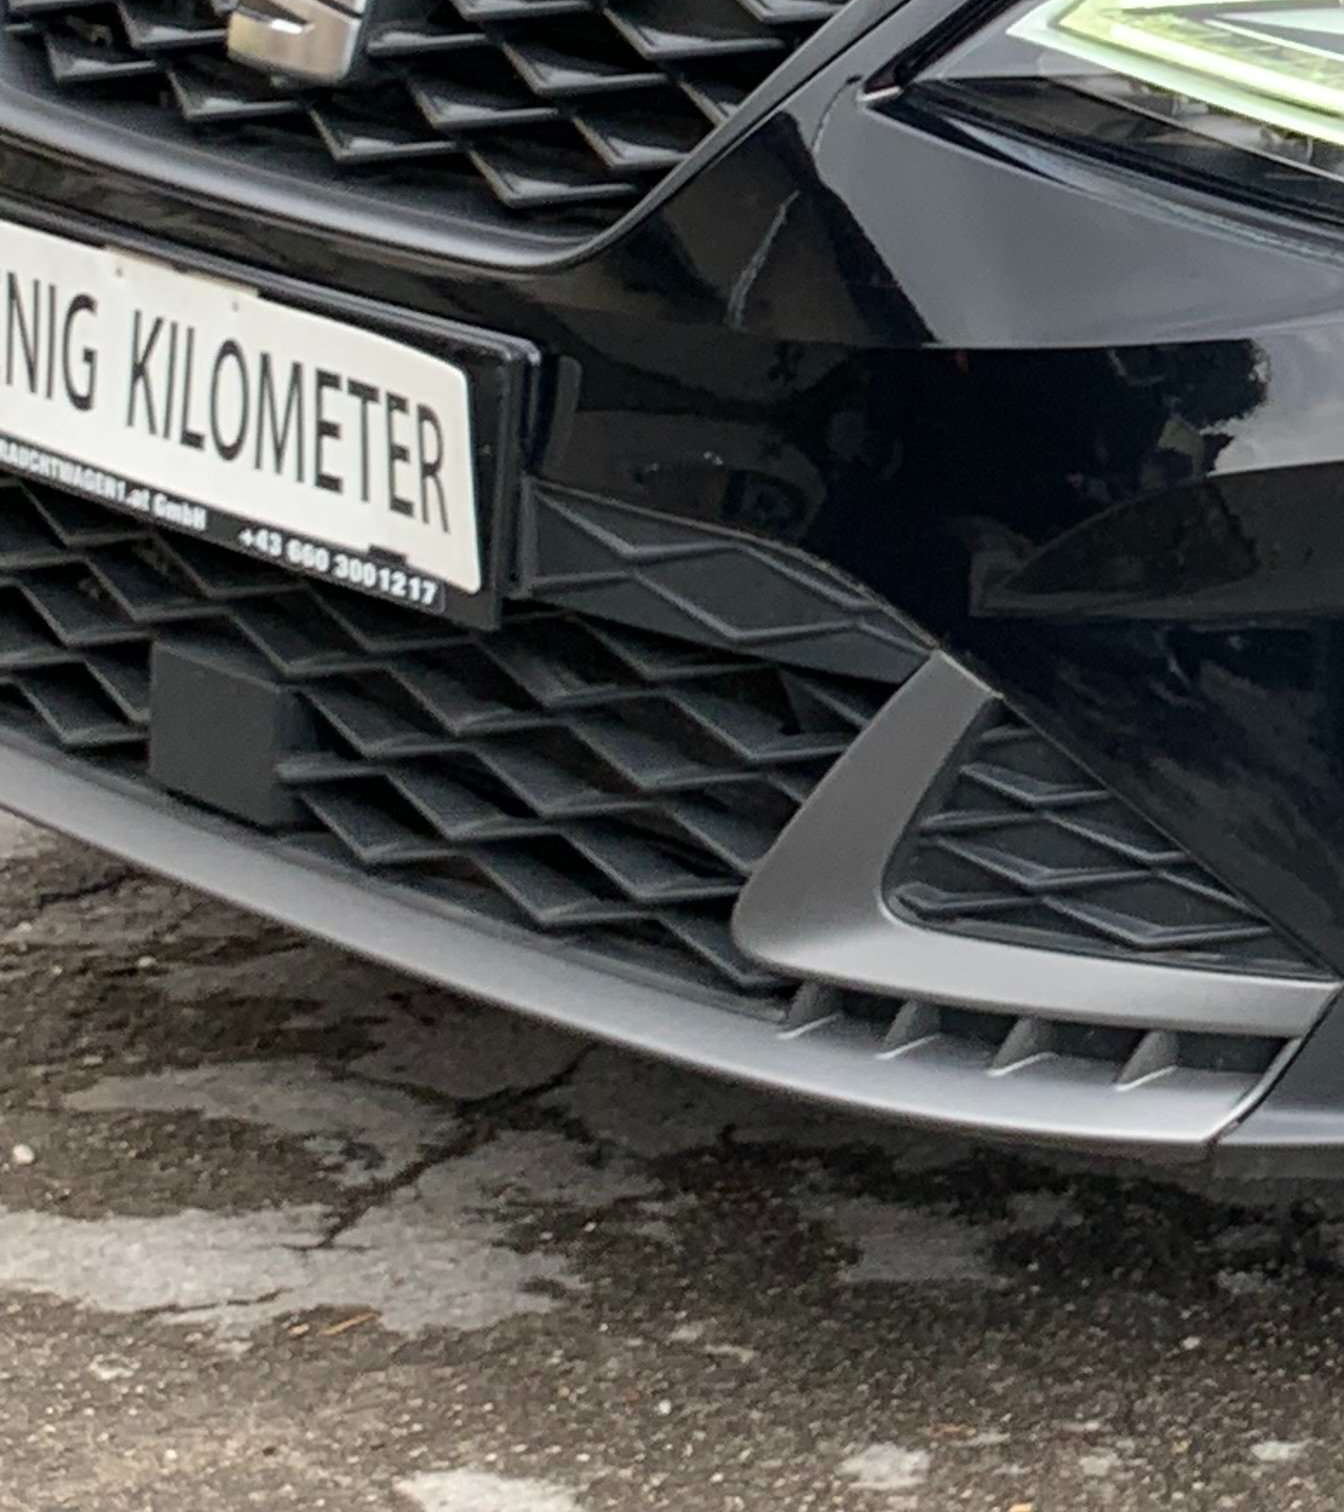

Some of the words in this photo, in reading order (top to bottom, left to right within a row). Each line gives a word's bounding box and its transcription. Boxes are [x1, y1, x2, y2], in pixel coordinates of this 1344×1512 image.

[6, 270, 99, 412] NIG
[126, 308, 451, 535] KILOMETER
[239, 528, 283, 557] +43
[333, 553, 438, 605] 3001217
